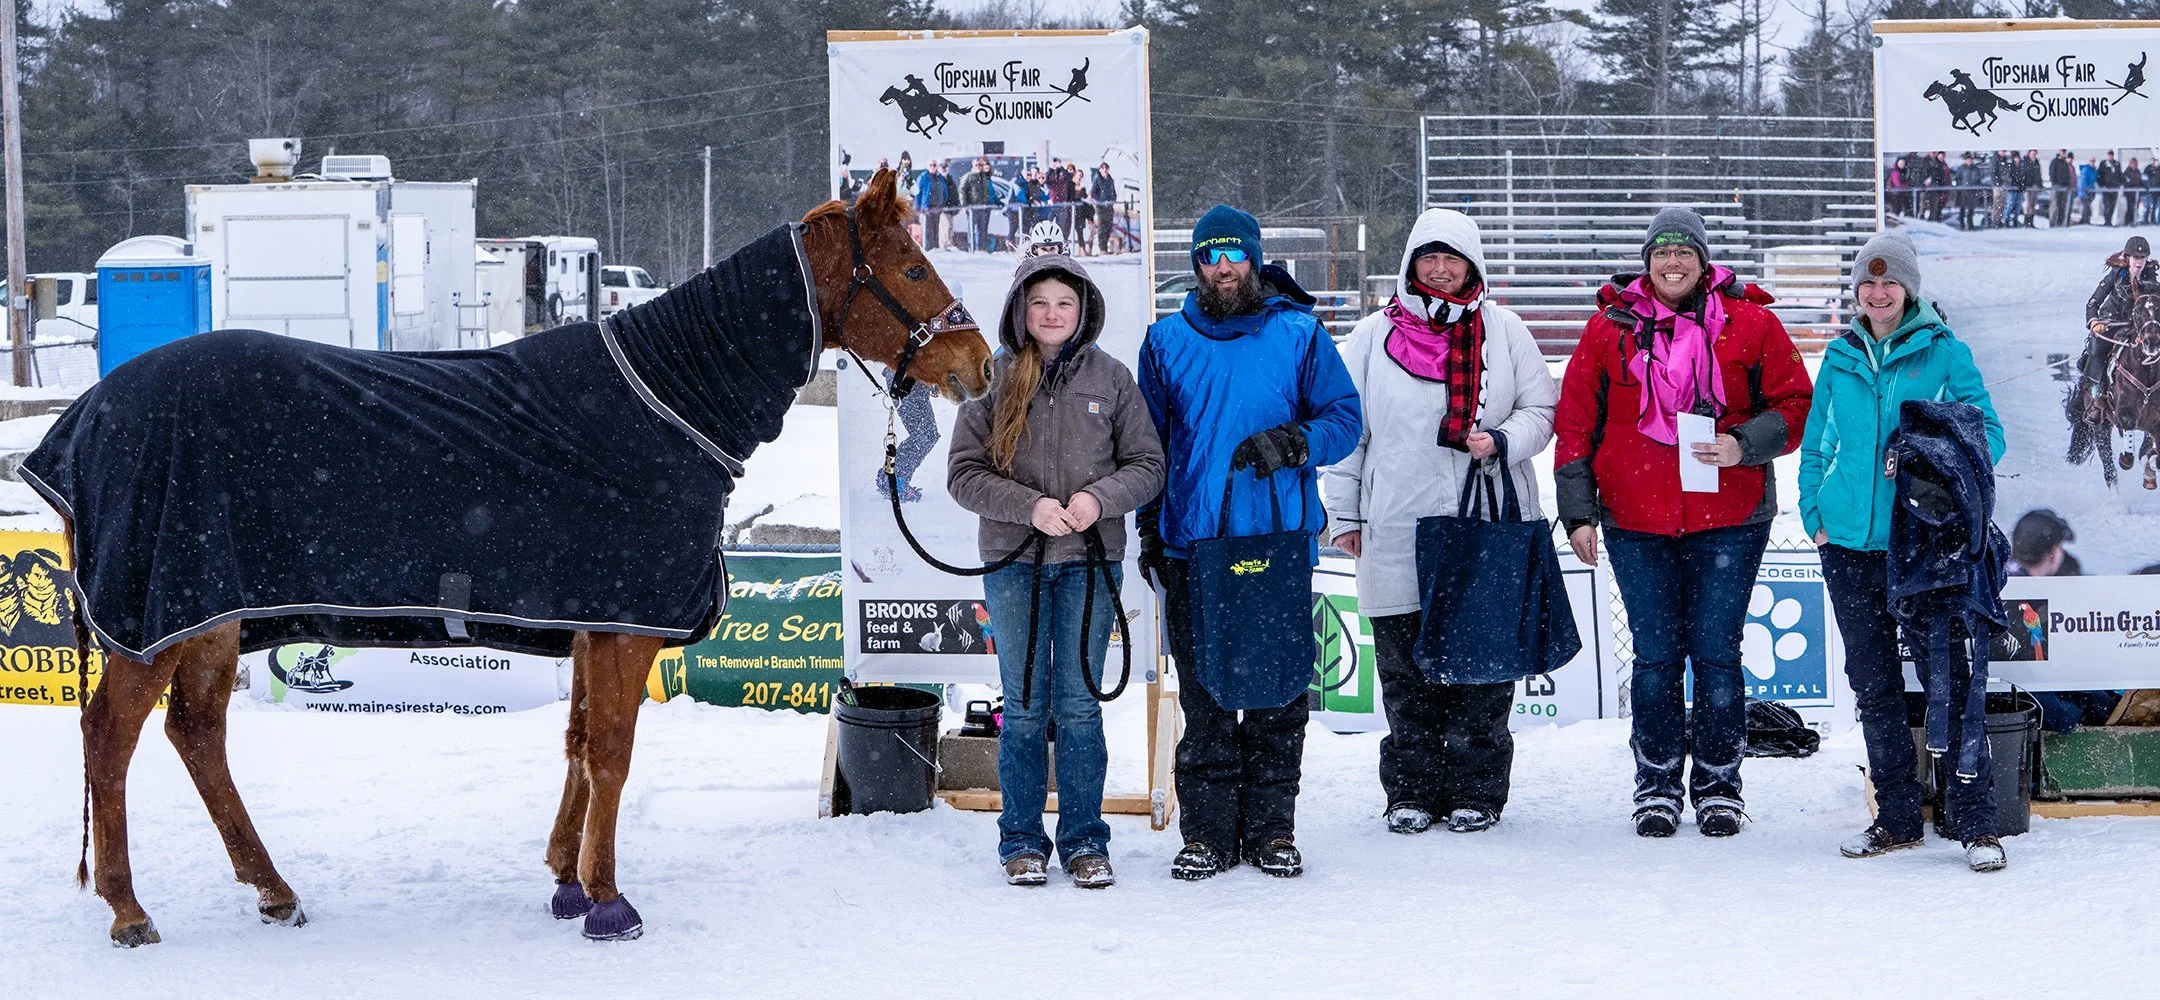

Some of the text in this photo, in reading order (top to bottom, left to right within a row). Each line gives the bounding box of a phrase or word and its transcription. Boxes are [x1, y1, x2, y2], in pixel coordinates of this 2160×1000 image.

[865, 602, 938, 619] BROOKS
[708, 614, 770, 642] Tree
[866, 620, 914, 634] feed &
[867, 636, 901, 649] farm
[409, 651, 511, 671] Association
[695, 655, 718, 668] Tree
[720, 655, 763, 669] Removal
[771, 655, 807, 669] Branch
[741, 681, 829, 708] 207-841
[1516, 703, 1558, 717] 300
